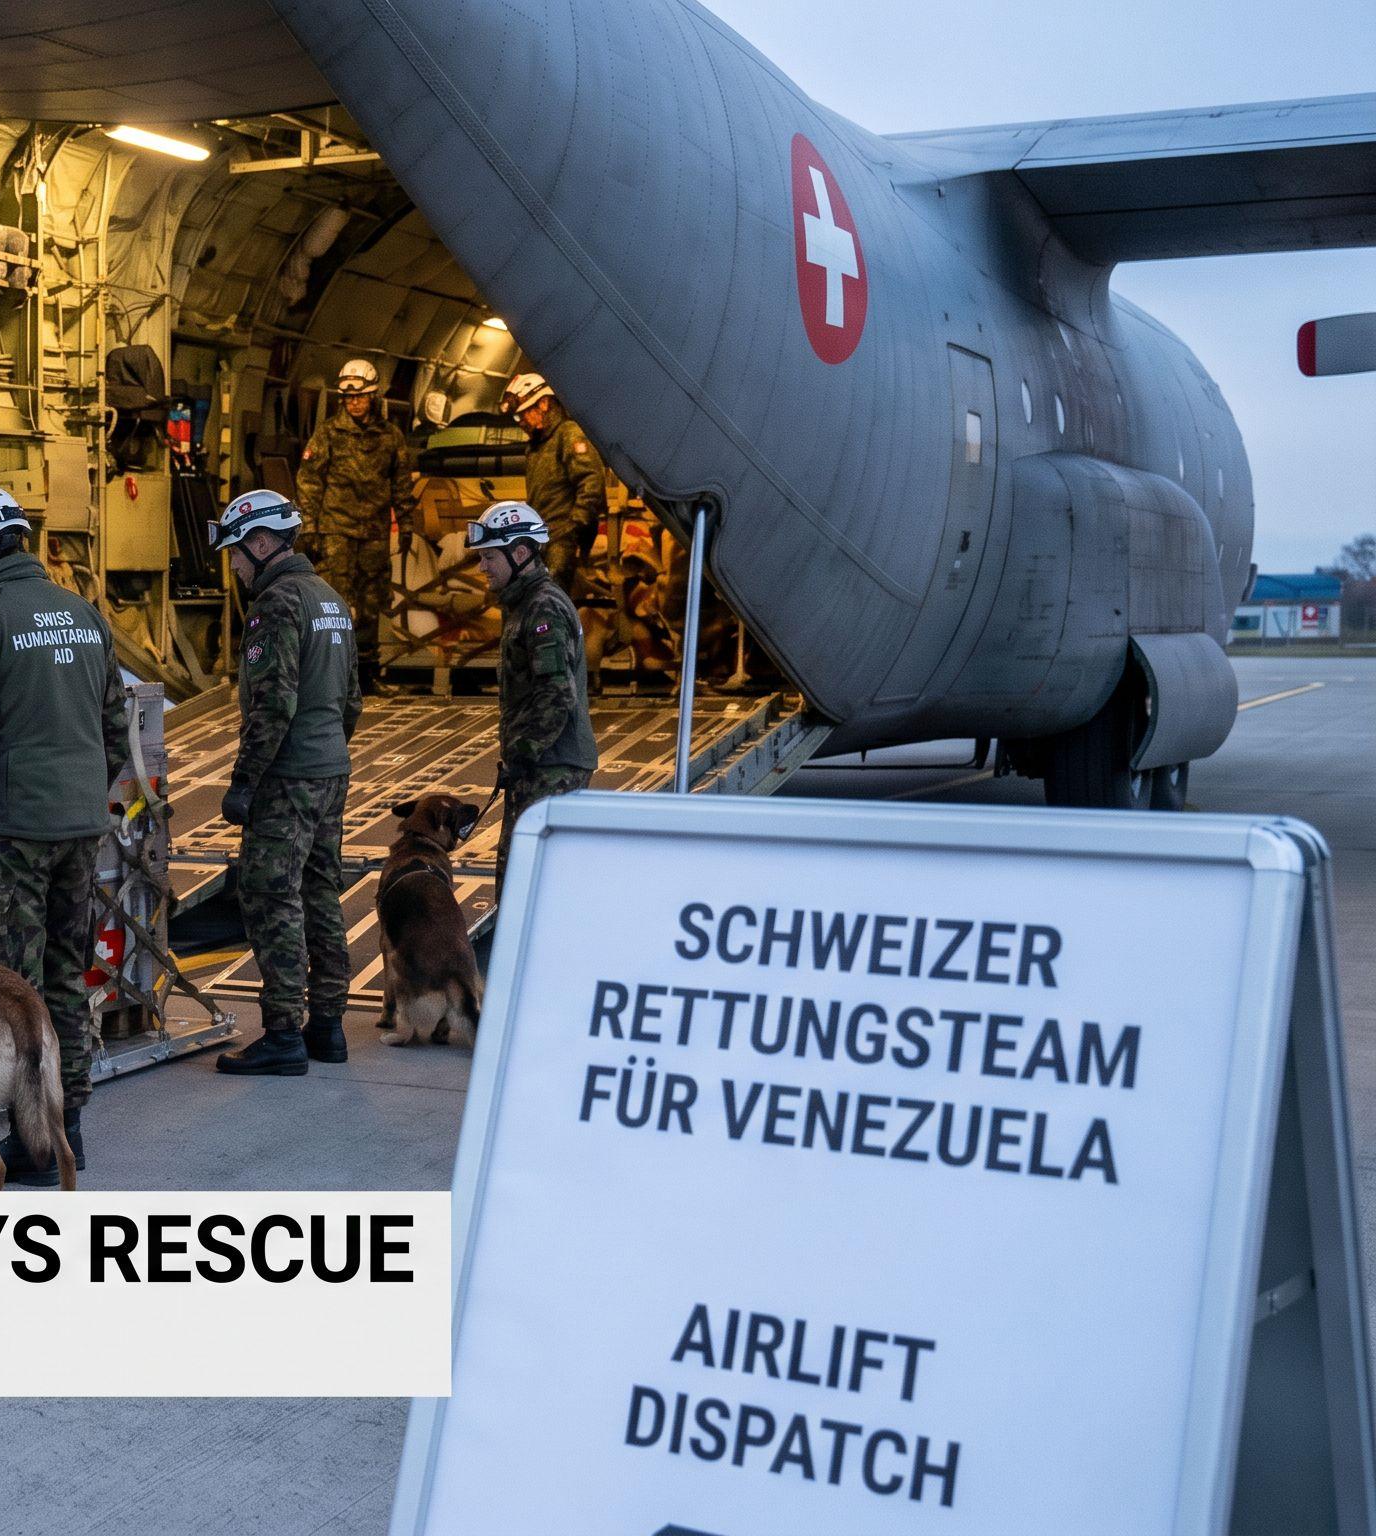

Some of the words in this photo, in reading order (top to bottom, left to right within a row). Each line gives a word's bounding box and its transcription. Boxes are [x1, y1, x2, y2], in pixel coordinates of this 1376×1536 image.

[12, 628, 102, 650] HUMANITARIAN
[33, 610, 74, 627] SWISS
[54, 647, 74, 664] AID
[674, 902, 1063, 989] SCHWEIZER
[588, 979, 1142, 1091] RETTUNGSTEAM
[578, 1054, 699, 1135] FÜR
[721, 1078, 1119, 1186] VENEZUELA
[670, 1303, 937, 1403] AIRLIFT
[624, 1384, 962, 1509] DISPATCH
